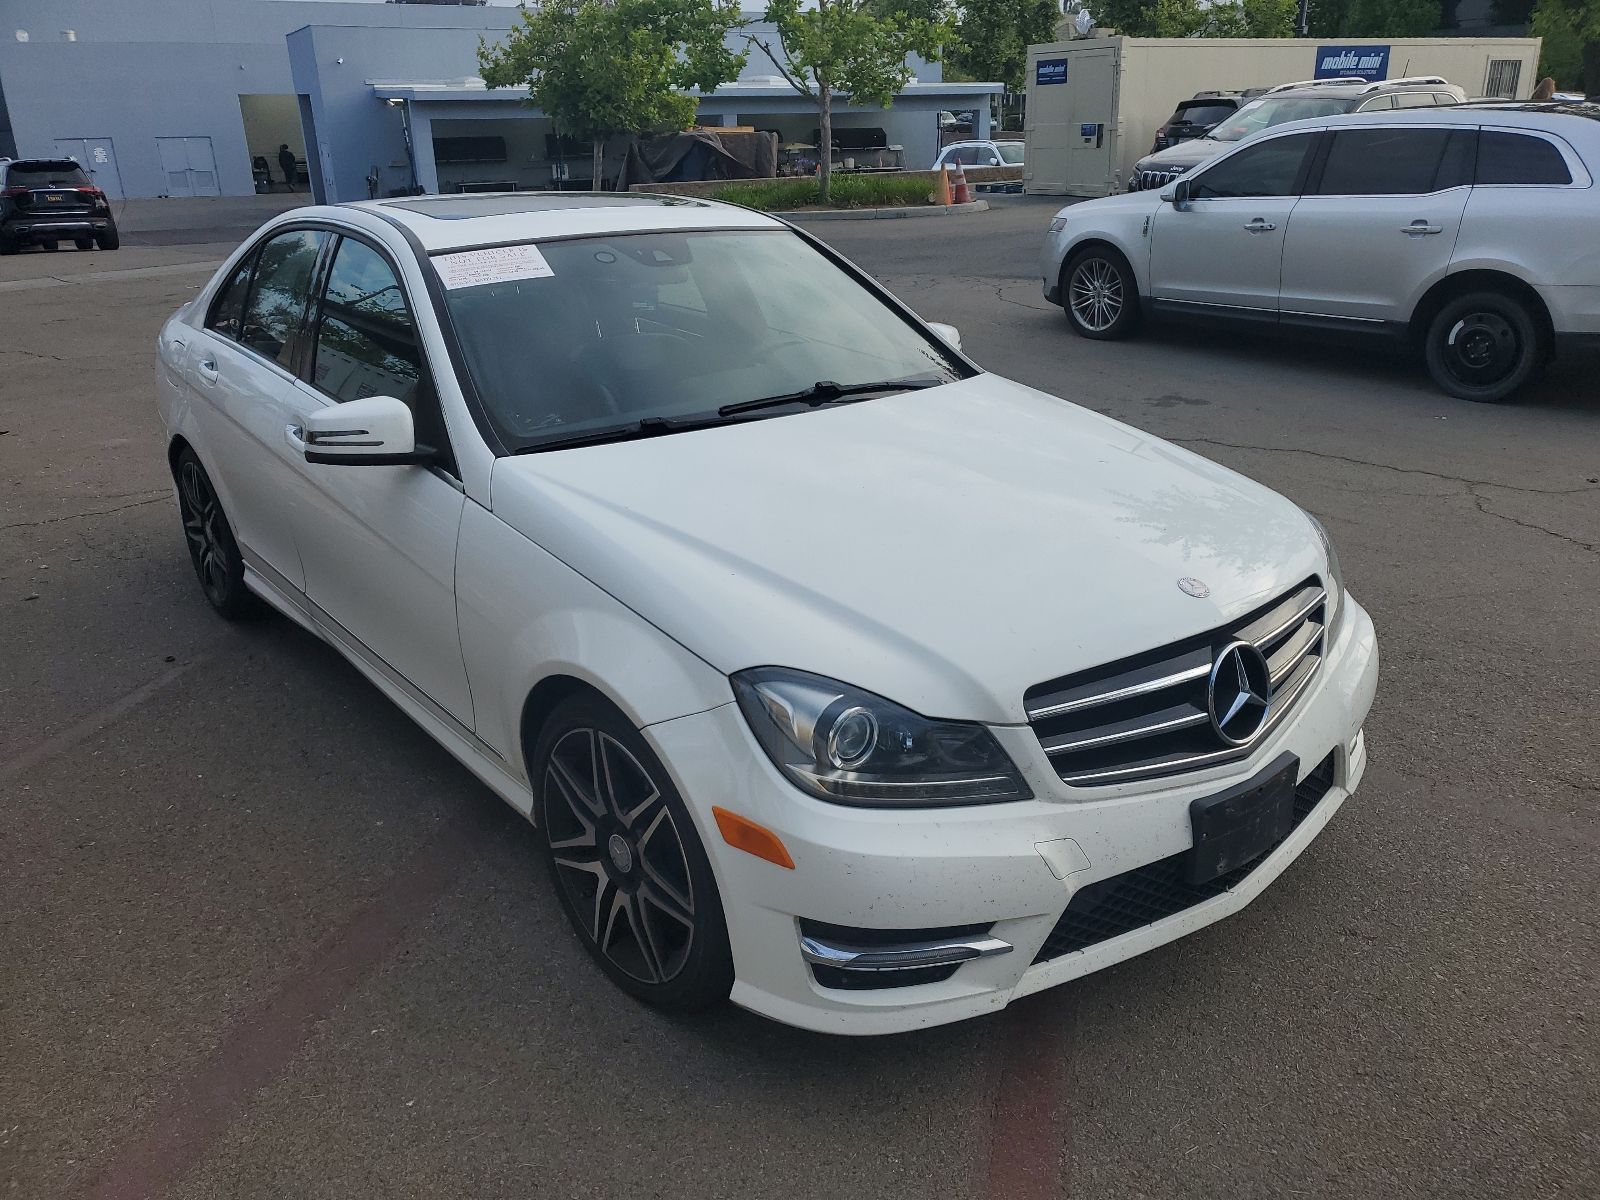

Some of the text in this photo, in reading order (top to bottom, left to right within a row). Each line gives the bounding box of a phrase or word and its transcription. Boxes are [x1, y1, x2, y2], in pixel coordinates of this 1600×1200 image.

[1321, 51, 1384, 69] mobile mini
[470, 248, 515, 258] VEHICLE
